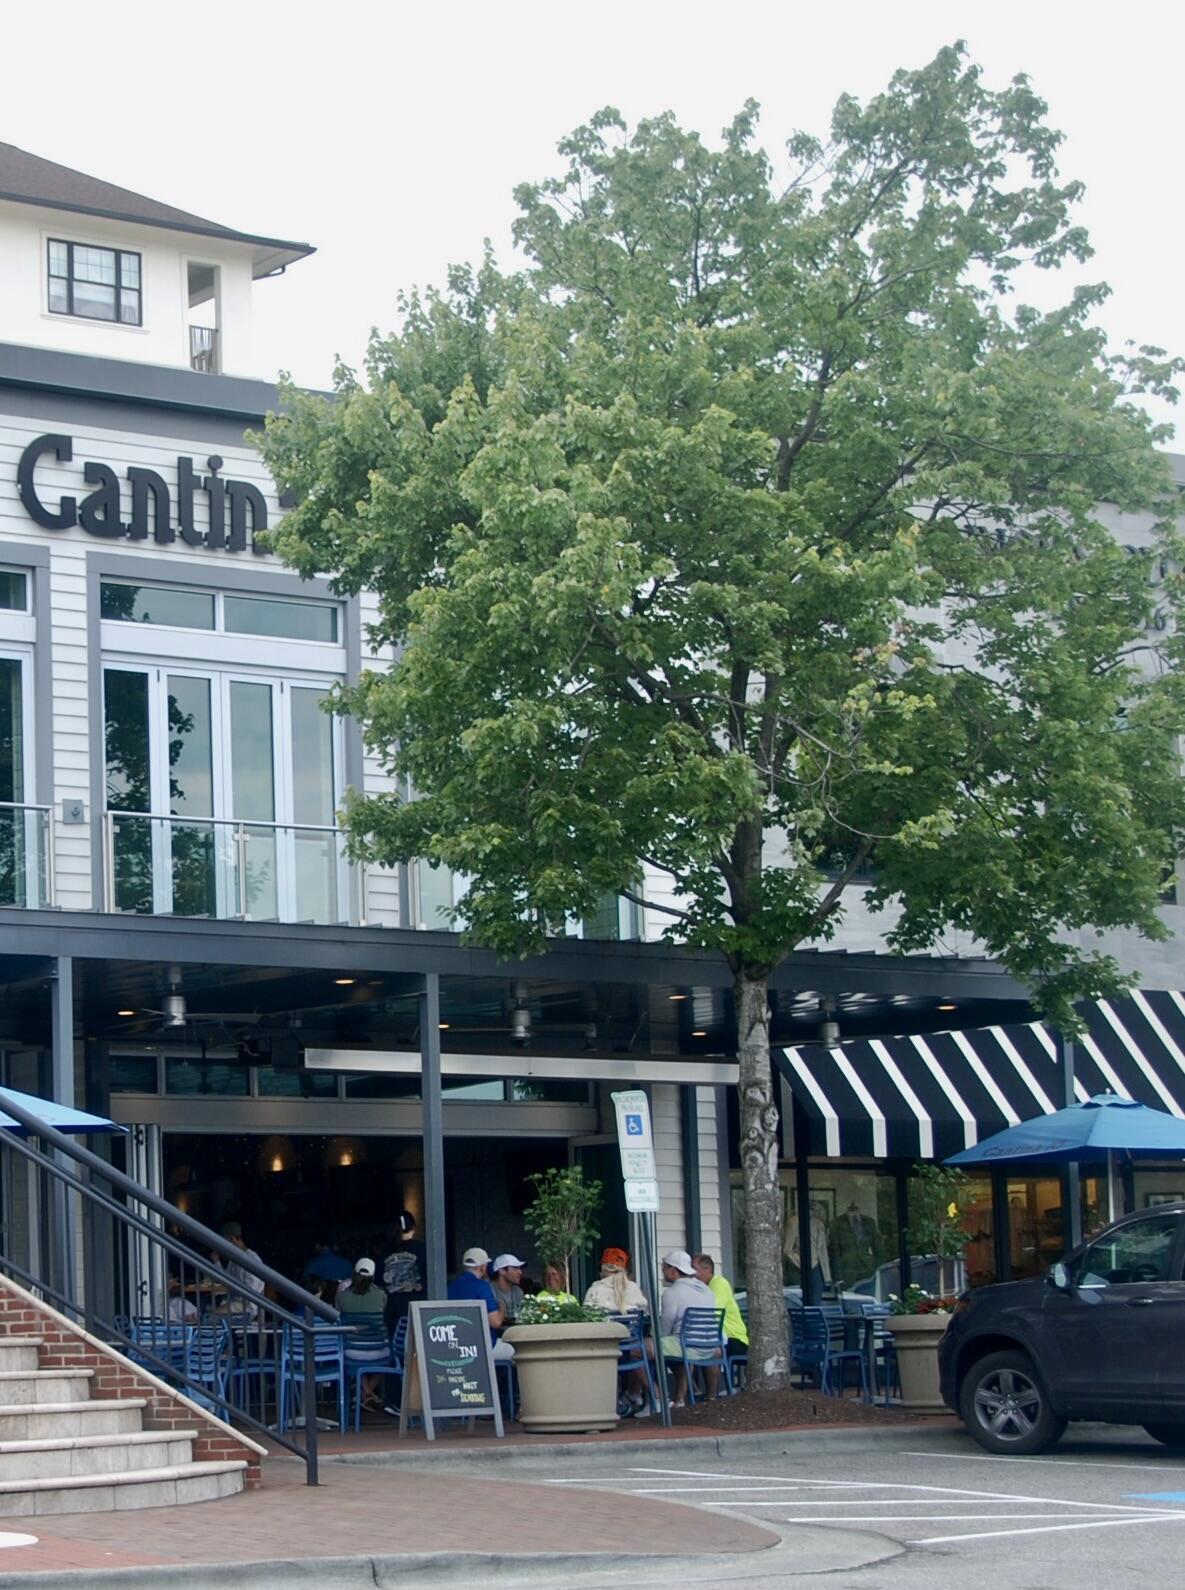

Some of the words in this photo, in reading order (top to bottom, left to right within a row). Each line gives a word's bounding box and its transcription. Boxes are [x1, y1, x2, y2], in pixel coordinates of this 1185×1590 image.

[17, 433, 297, 555] Cantin
[429, 1325, 458, 1342] COME
[459, 1345, 477, 1358] IN!
